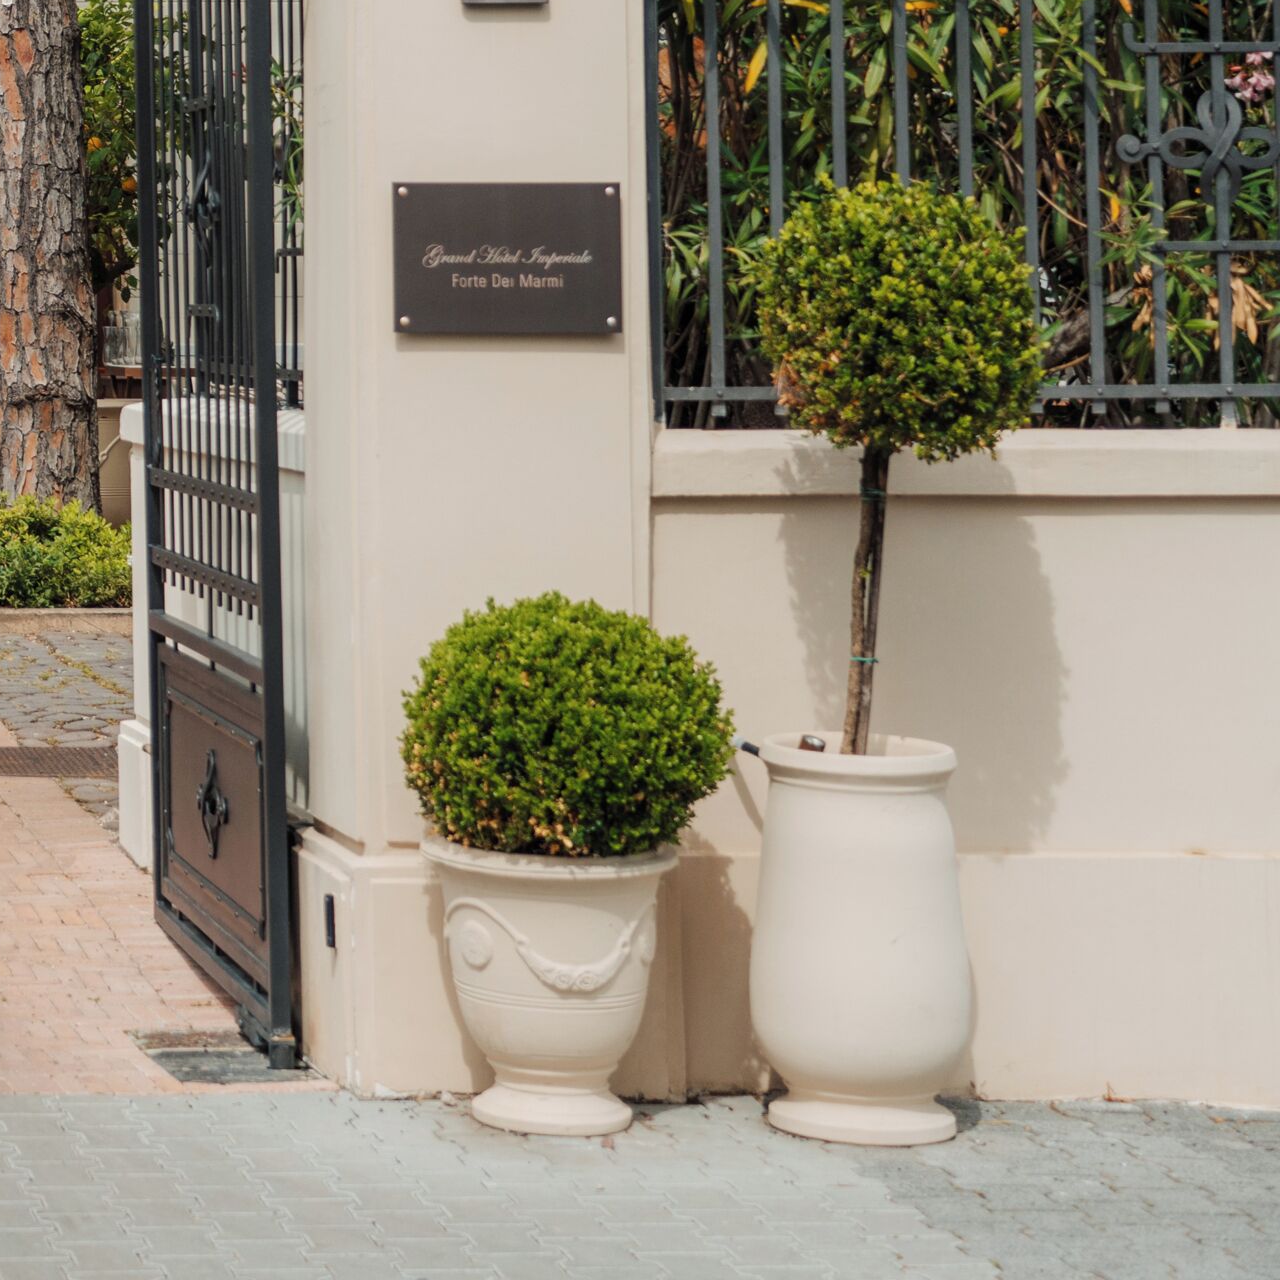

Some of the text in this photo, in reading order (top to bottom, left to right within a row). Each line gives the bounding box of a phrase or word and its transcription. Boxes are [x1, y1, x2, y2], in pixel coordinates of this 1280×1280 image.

[422, 244, 593, 270] Grand Hotel Imperiale
[451, 273, 564, 288] Forte Dei Marmi
